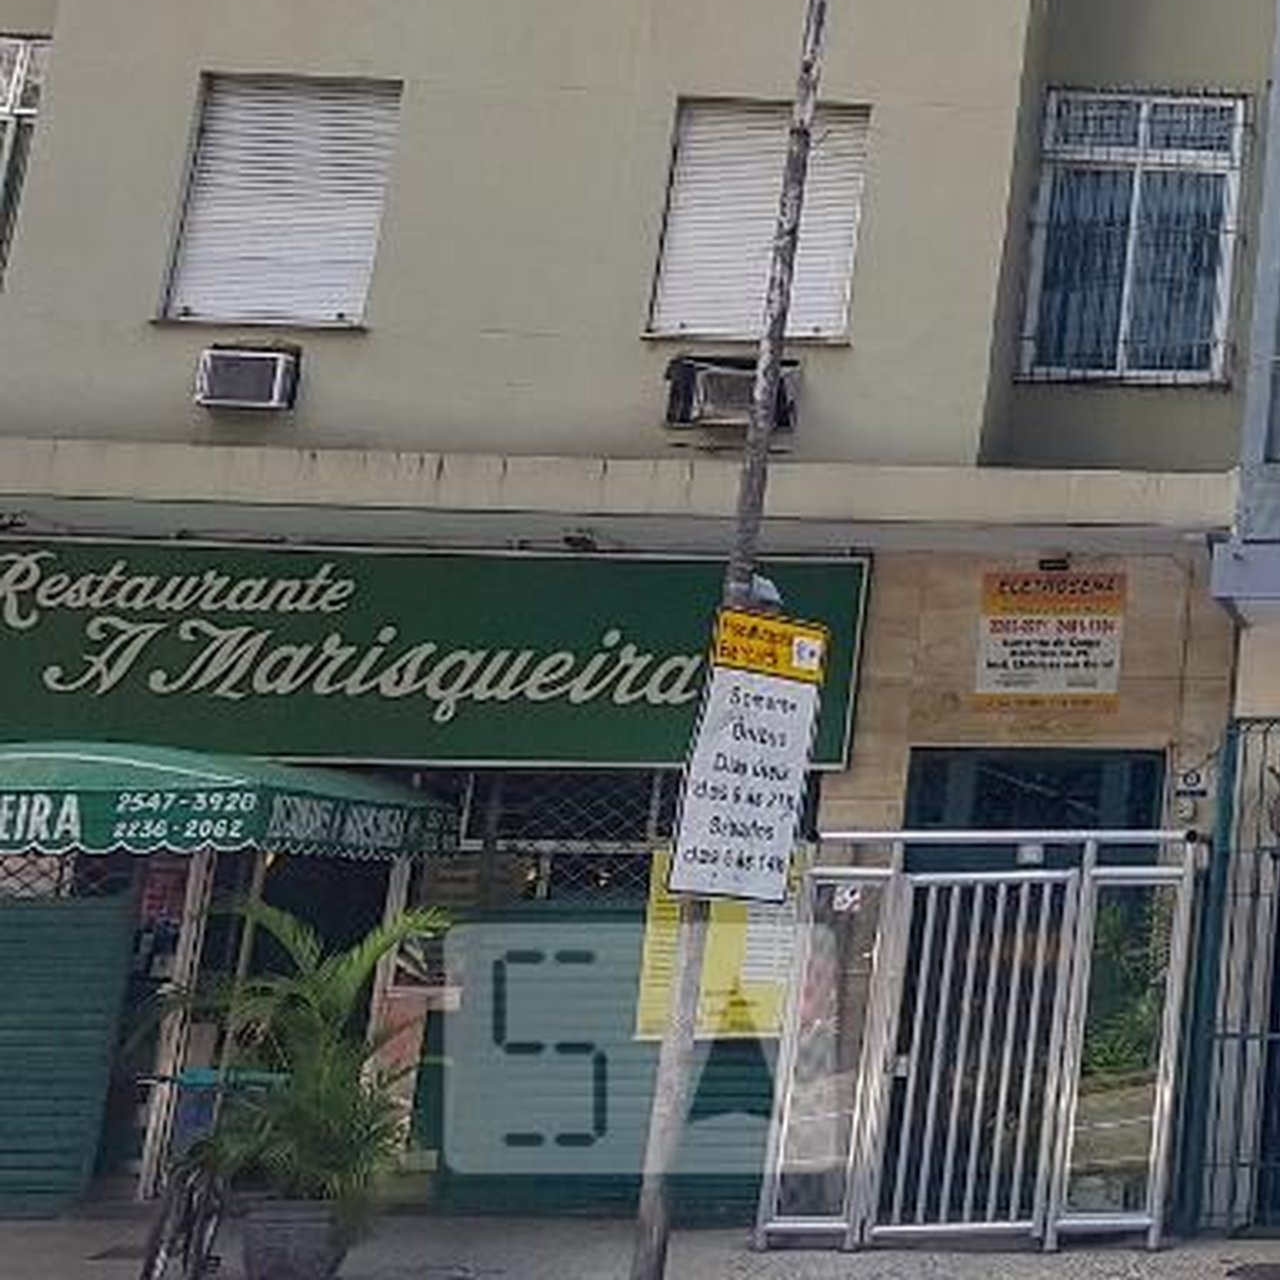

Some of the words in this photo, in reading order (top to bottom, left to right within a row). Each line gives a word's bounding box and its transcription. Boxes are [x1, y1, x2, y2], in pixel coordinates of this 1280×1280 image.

[0, 550, 356, 629] Restaurante
[42, 615, 169, 695] A
[149, 617, 701, 721] Marisqueira
